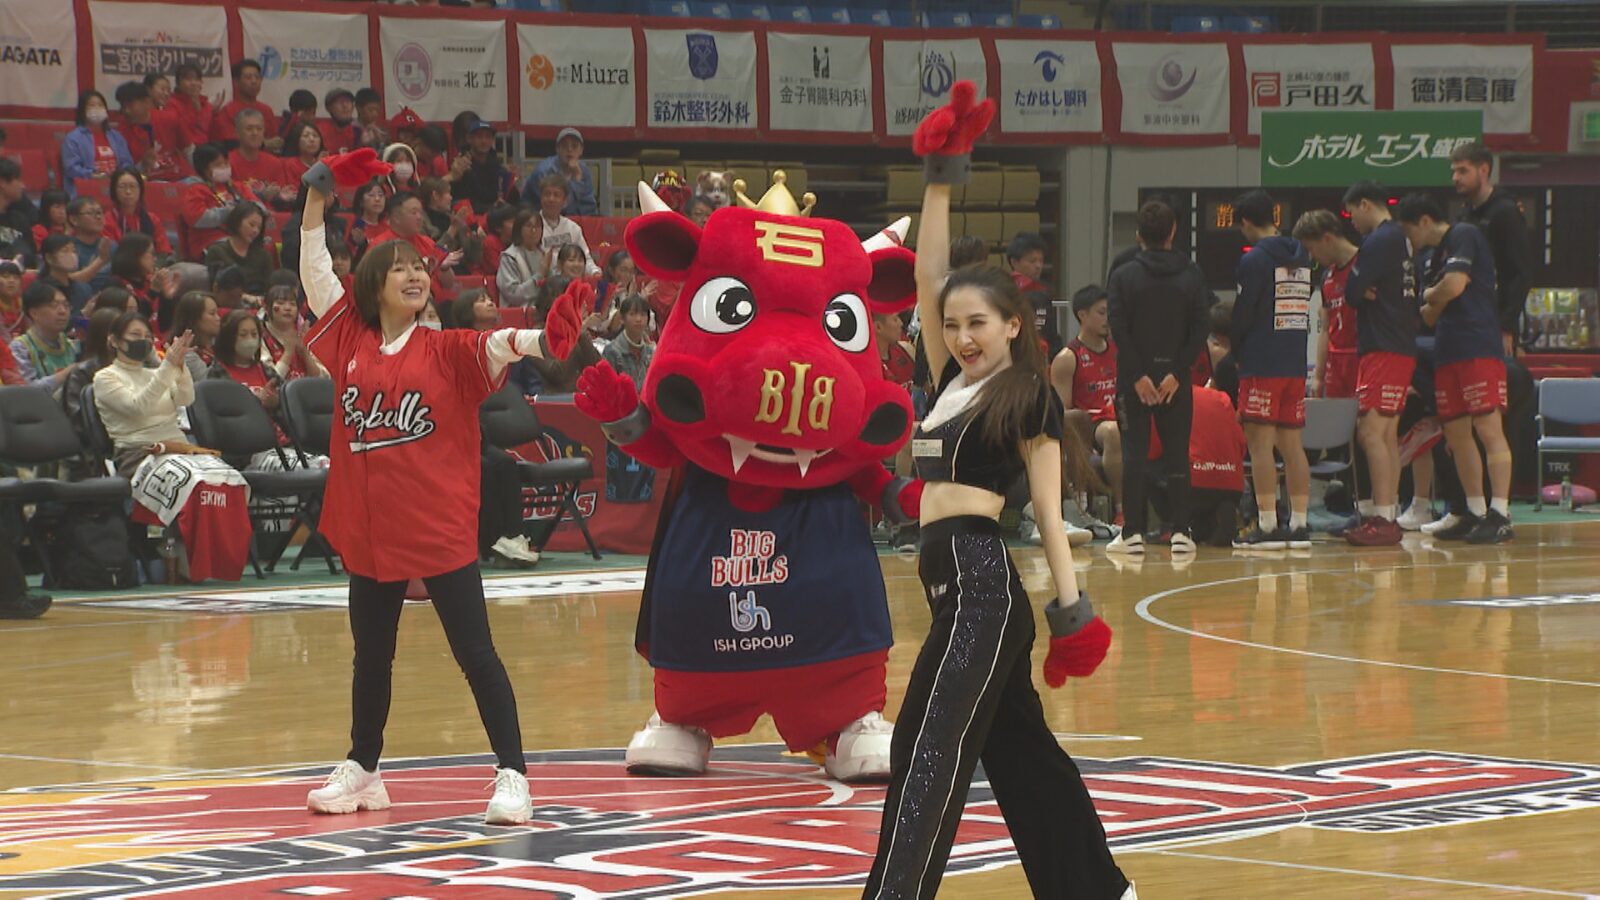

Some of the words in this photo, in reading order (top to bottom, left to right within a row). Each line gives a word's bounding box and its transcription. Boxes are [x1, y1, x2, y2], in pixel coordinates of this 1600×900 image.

[571, 61, 629, 84] Miura
[780, 85, 866, 107] 金子胃腸科内科
[1015, 89, 1087, 107] たかはし眼科
[1285, 84, 1369, 107] 戸田久
[1411, 77, 1517, 103] 徳清倉庫
[654, 99, 750, 124] 鈴木整形外科
[731, 529, 776, 559] BIG
[711, 555, 789, 587] BULLS
[714, 638, 737, 652] ISH
